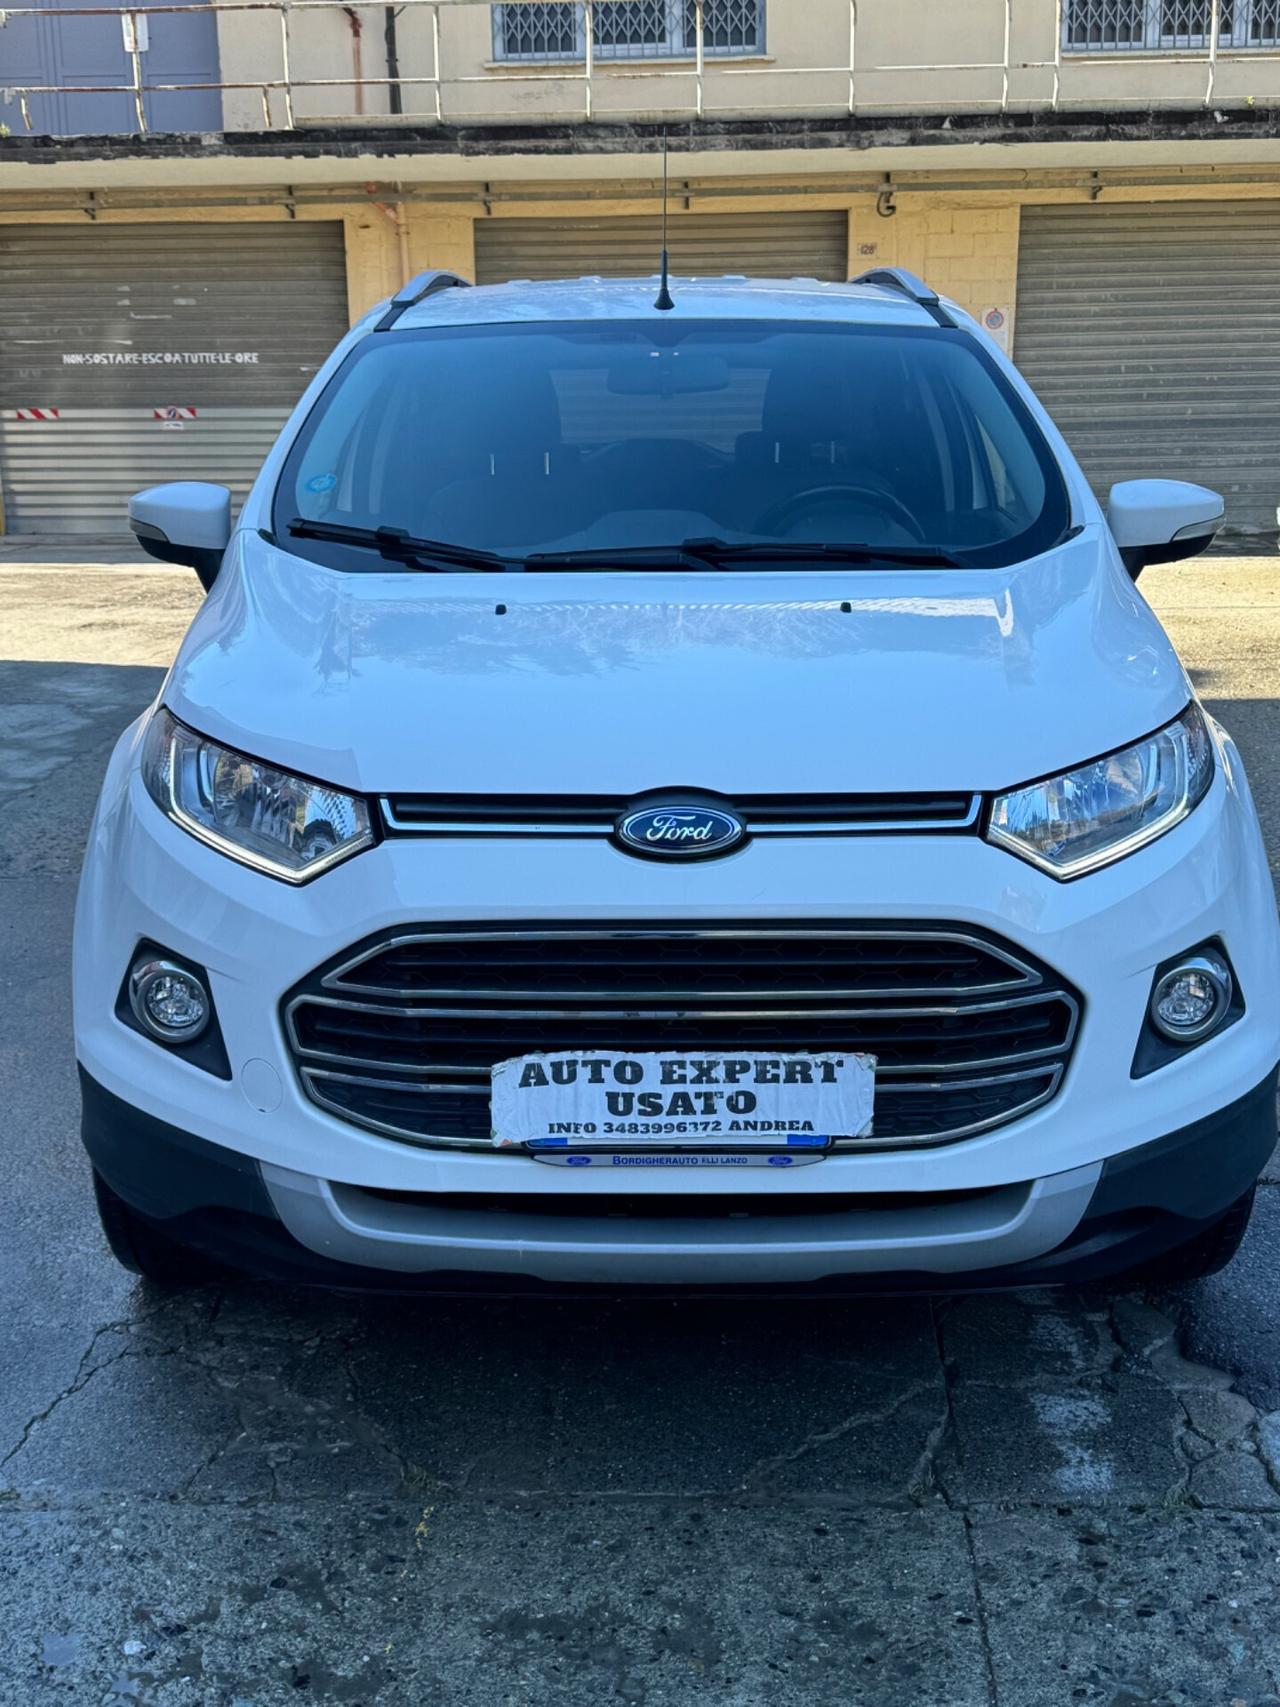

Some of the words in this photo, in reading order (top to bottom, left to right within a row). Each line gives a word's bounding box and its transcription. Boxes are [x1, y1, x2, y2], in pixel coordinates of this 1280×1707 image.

[646, 815, 713, 840] Ford
[518, 1059, 644, 1088] AUTO
[659, 1059, 845, 1085] EXPERT
[605, 1090, 757, 1117] USATO
[548, 1122, 597, 1134] INFO
[603, 1120, 722, 1134] 3483996372
[728, 1120, 814, 1131] ANDREA
[612, 1155, 698, 1165] BORDIGHERAUTO
[720, 1156, 748, 1164] LANZO
